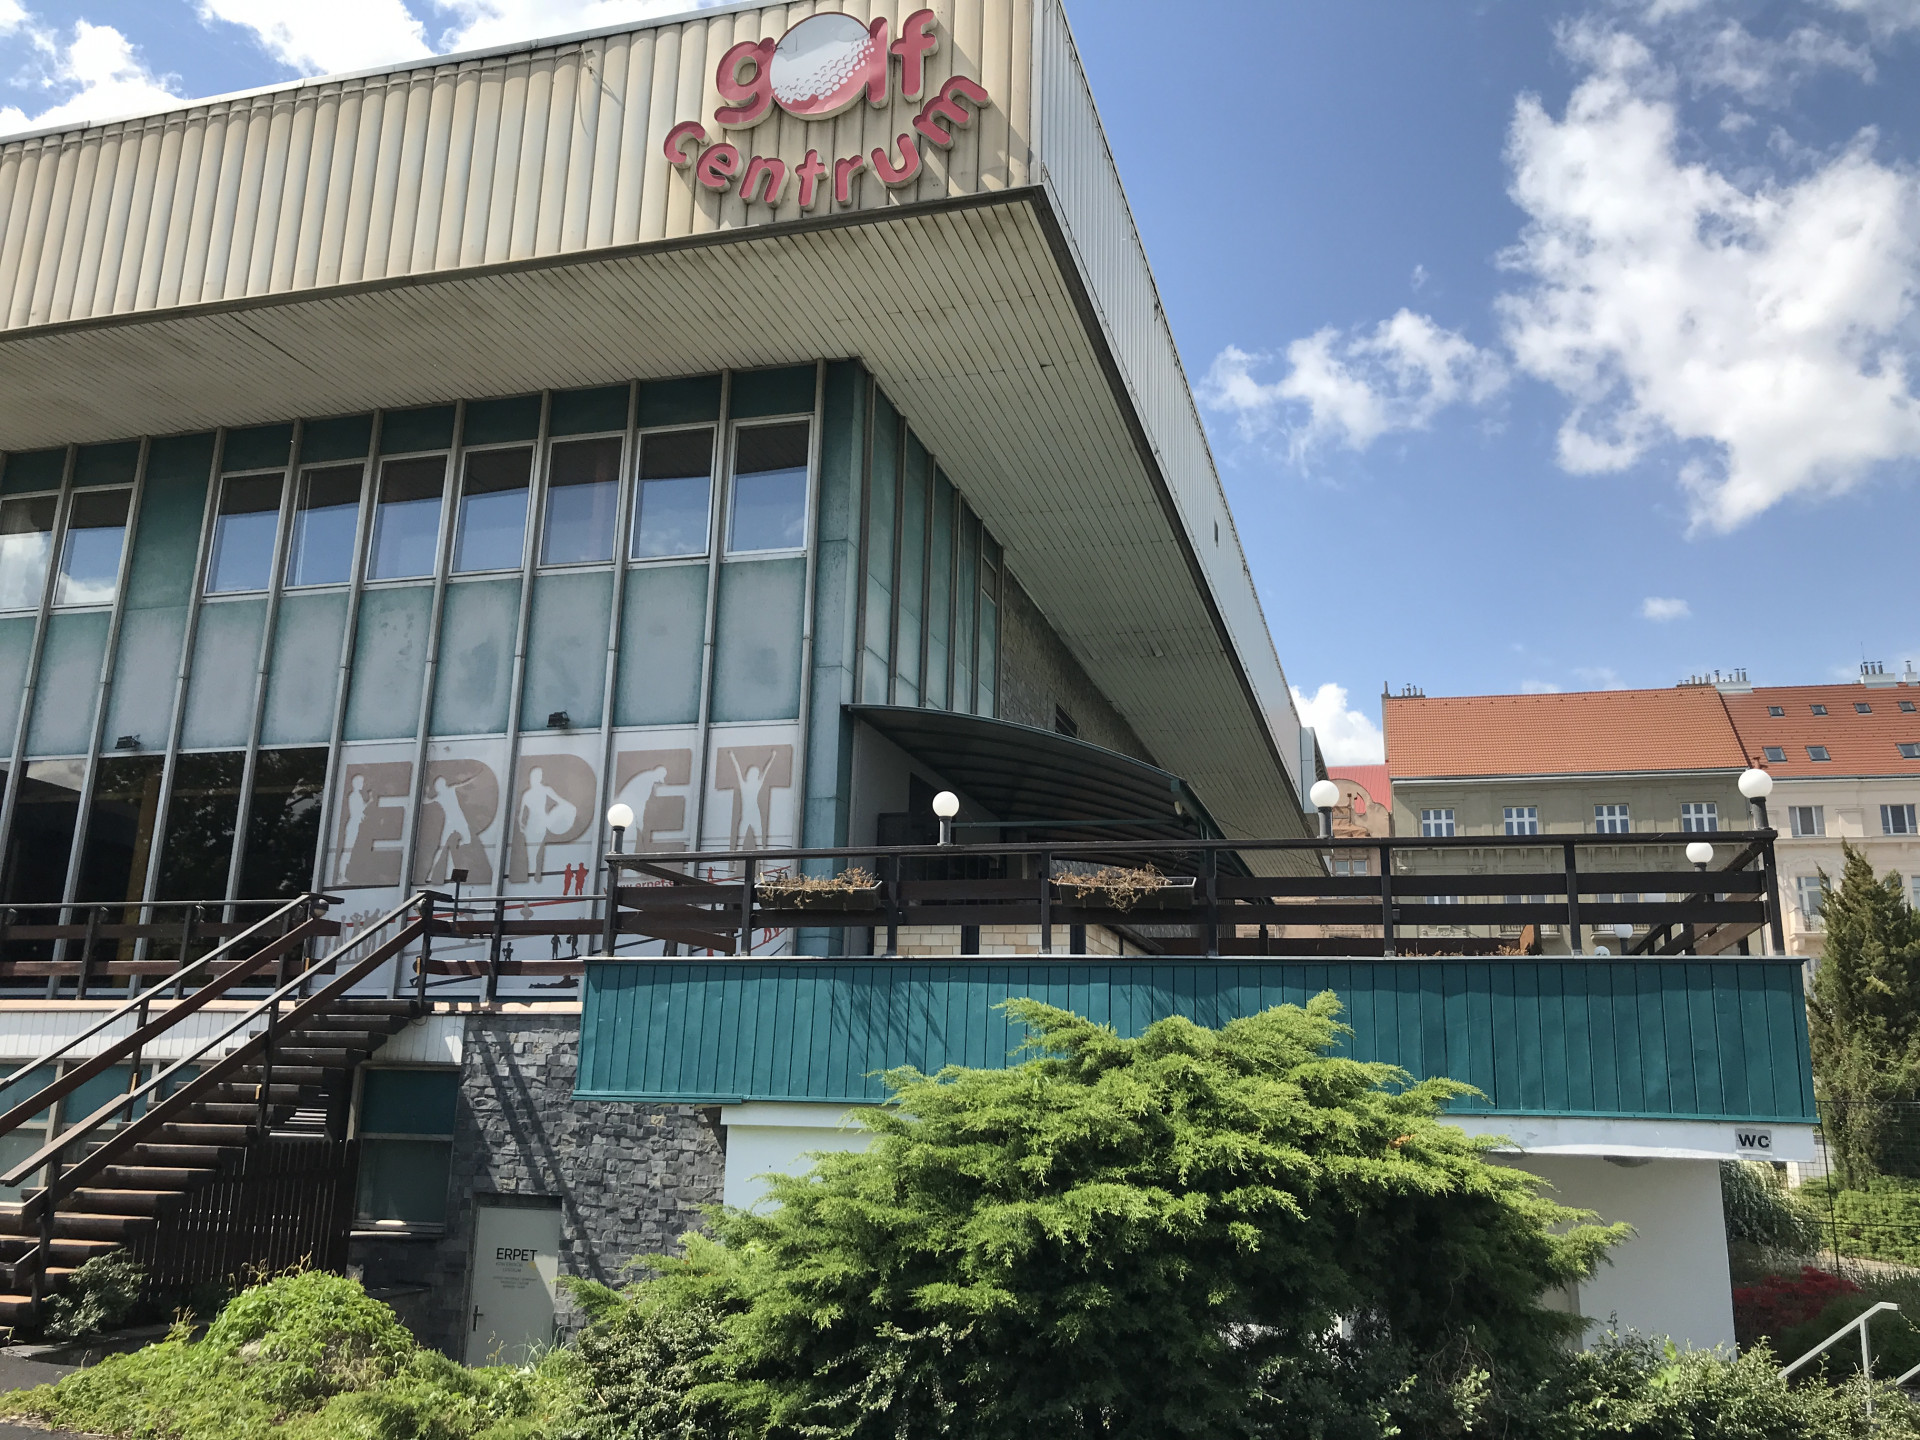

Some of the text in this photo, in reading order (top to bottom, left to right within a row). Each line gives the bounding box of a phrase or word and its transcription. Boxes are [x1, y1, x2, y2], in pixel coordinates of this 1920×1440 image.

[714, 8, 938, 130] golf
[663, 75, 992, 211] centrum
[332, 744, 793, 888] ERPET
[1738, 1133, 1770, 1148] WC
[496, 1247, 538, 1262] ERPET
